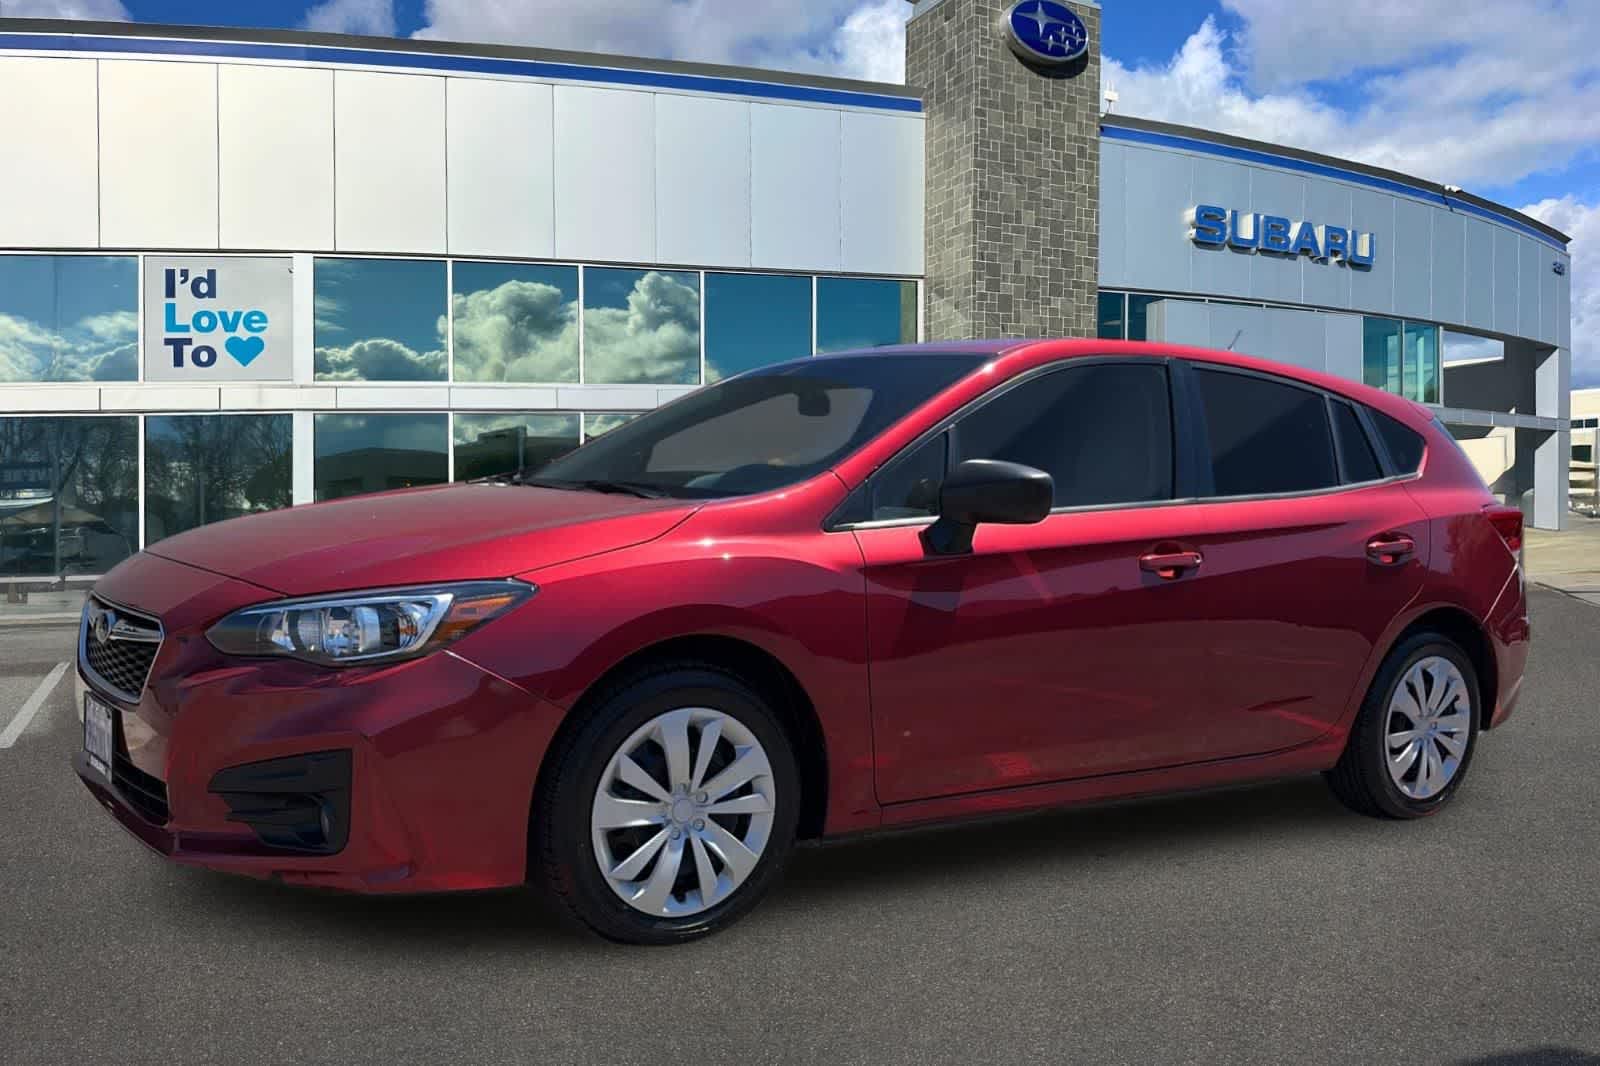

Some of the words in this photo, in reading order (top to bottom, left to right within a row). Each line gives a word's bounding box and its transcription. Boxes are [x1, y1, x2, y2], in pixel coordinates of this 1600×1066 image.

[1192, 204, 1375, 271] SUBARU
[165, 302, 268, 333] Love
[164, 337, 217, 368] To
